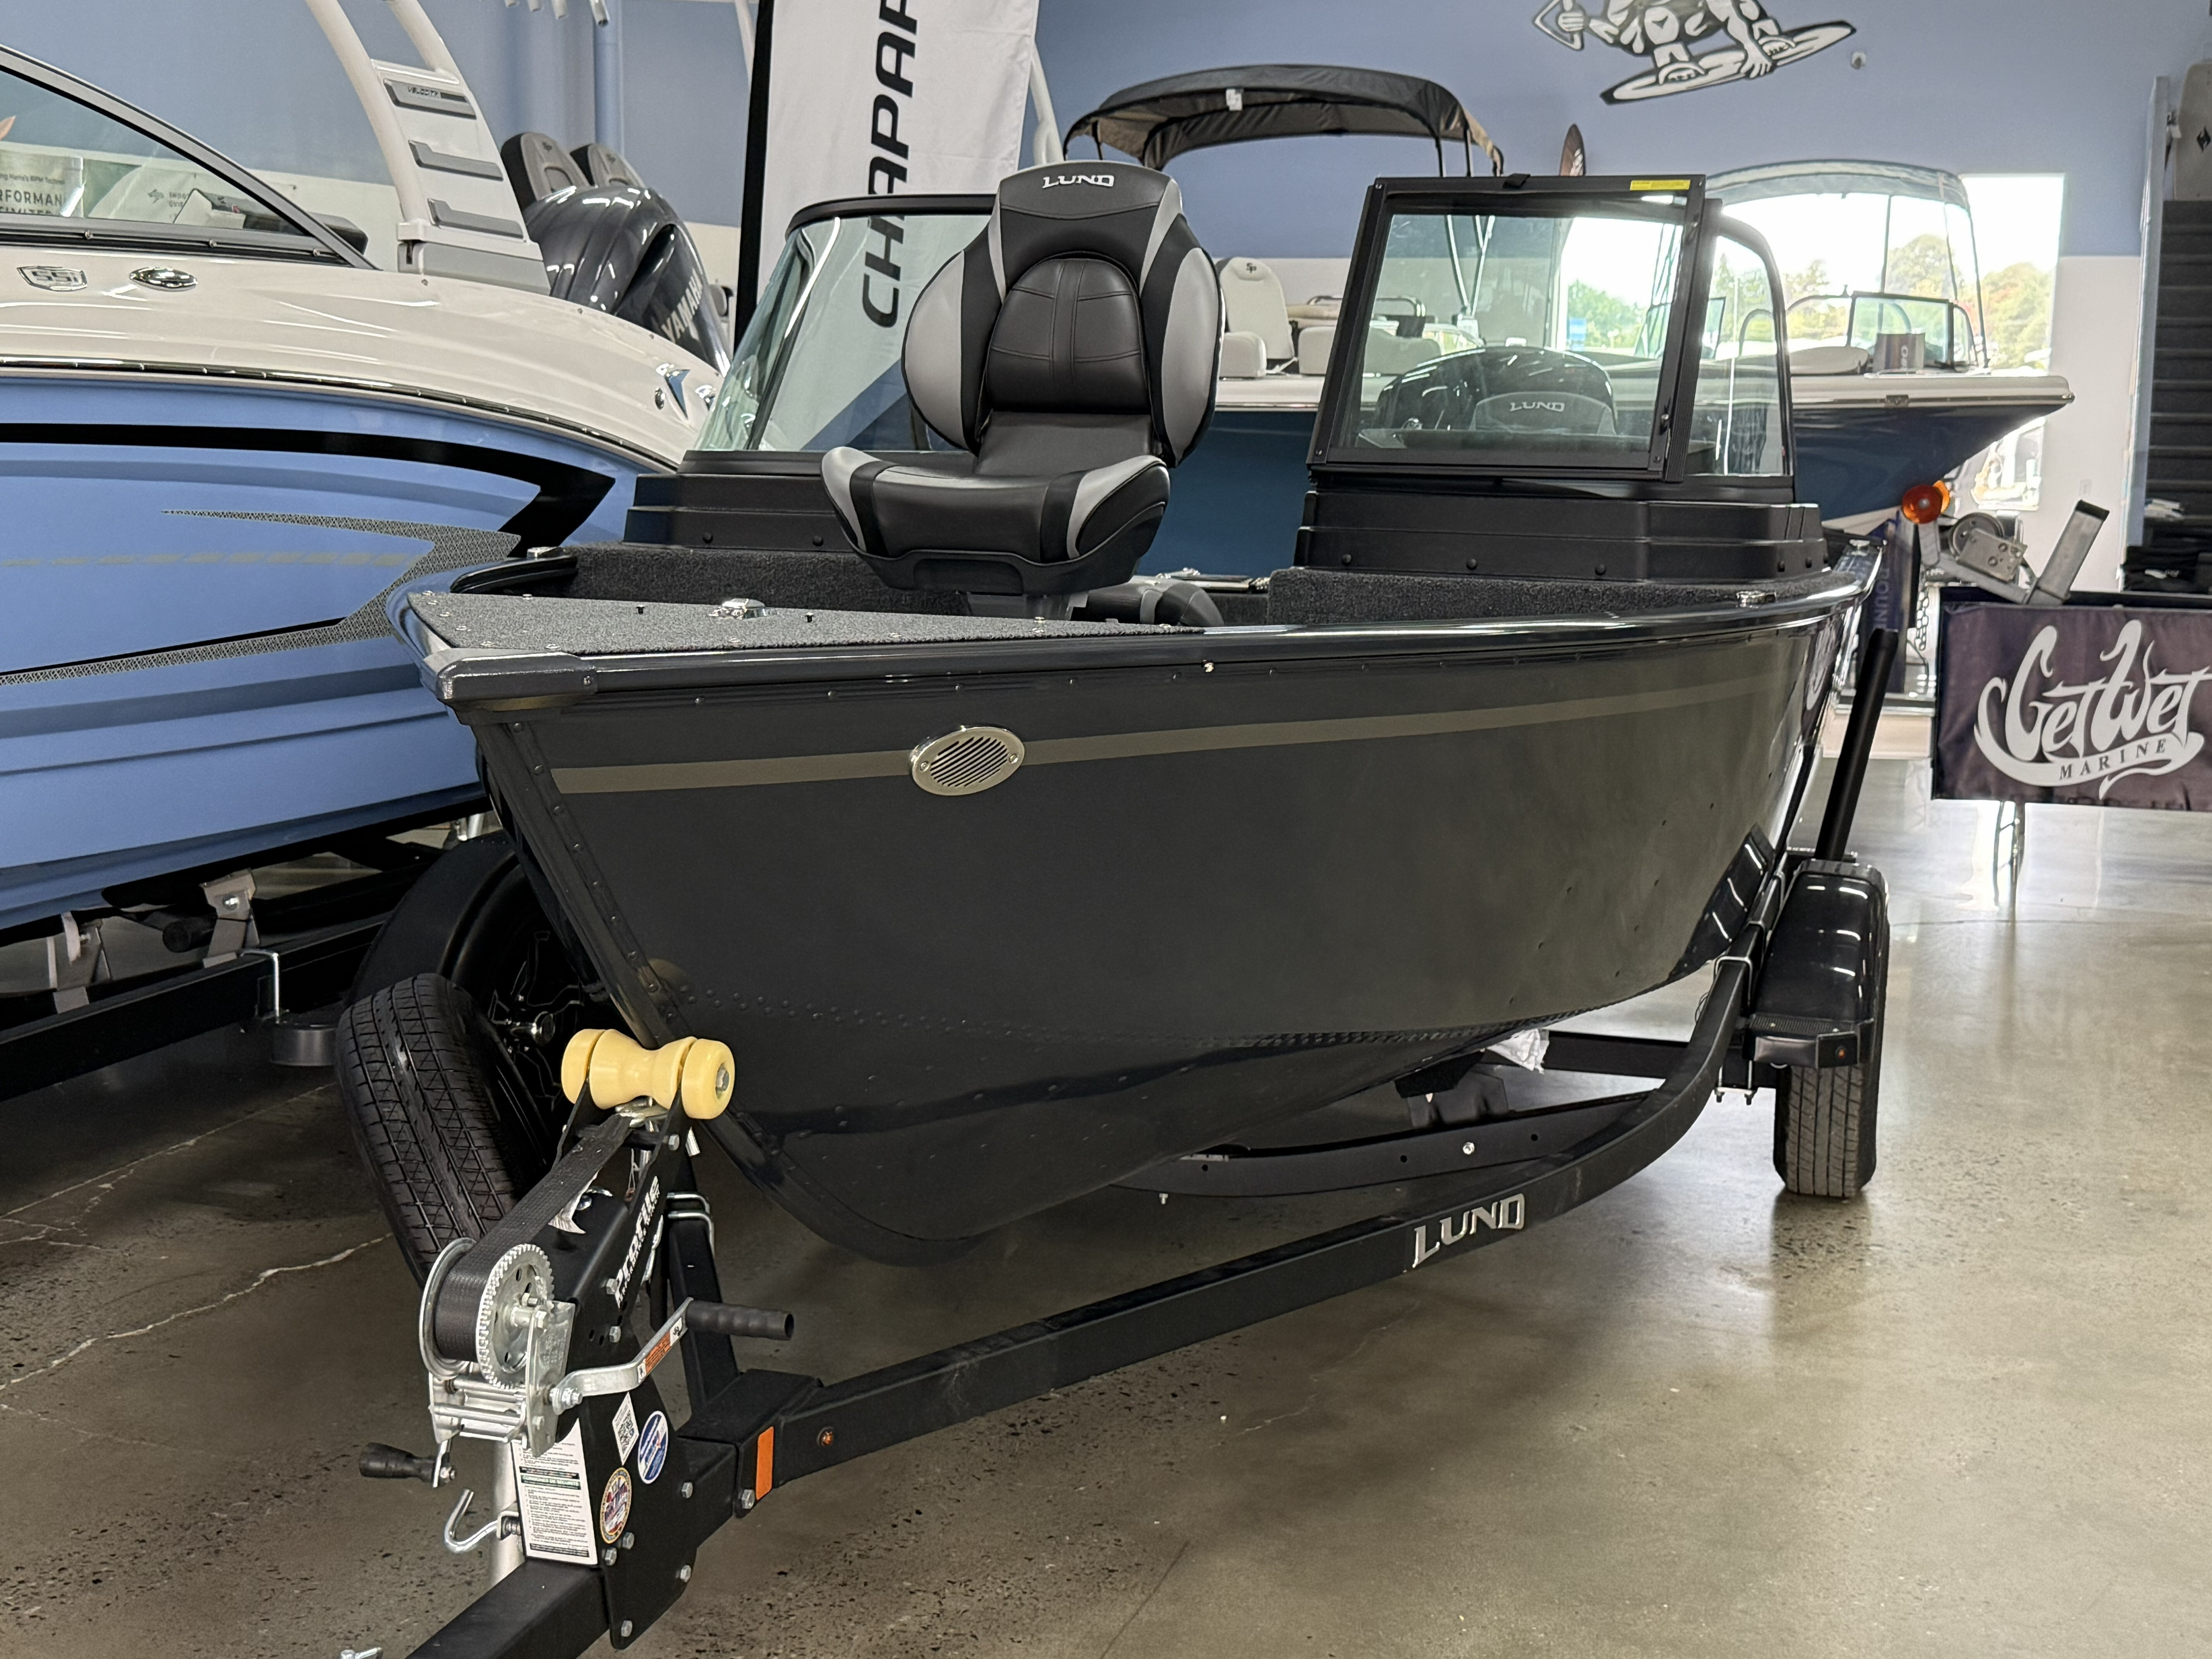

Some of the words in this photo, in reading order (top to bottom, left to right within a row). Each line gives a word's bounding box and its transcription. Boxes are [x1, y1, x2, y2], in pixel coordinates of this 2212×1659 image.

[1042, 174, 1115, 189] LUND
[1510, 401, 1565, 412] LUND
[2059, 738, 2167, 780] MARINE
[1412, 1193, 1525, 1268] LUND
